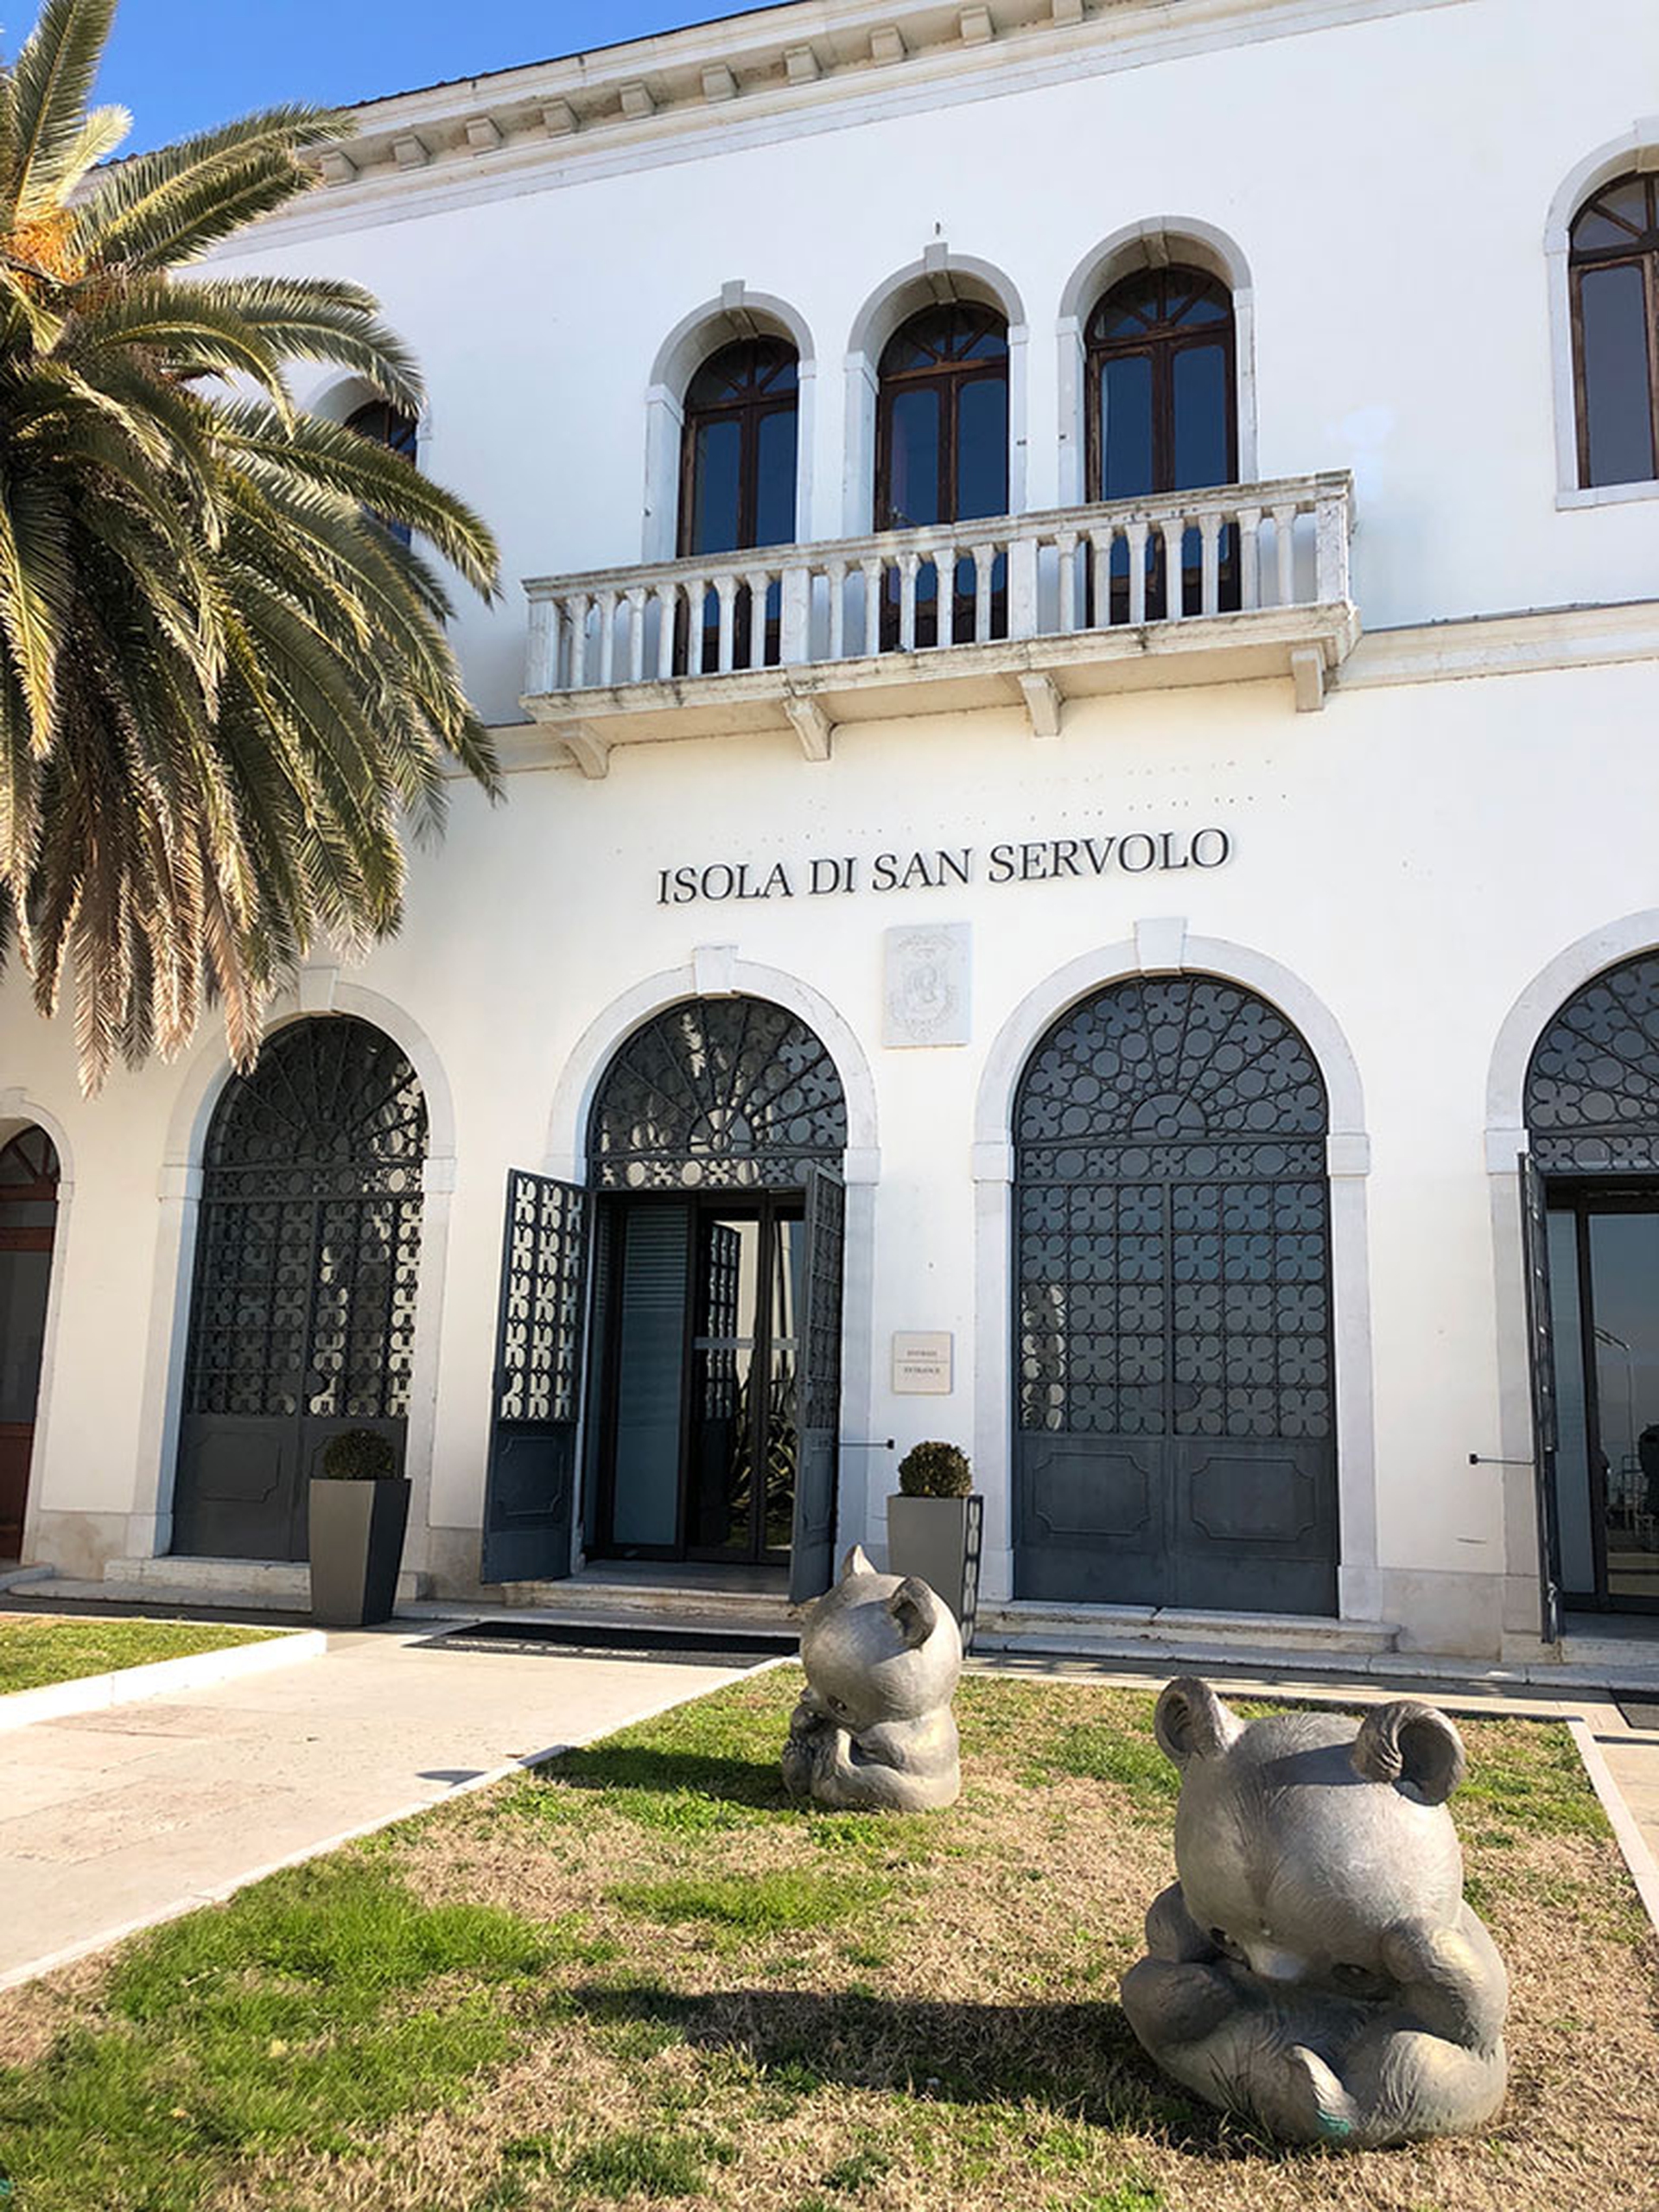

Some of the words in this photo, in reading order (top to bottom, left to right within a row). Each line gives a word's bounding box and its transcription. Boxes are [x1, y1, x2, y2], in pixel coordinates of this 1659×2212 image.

[657, 862, 794, 905] ISOLA
[809, 858, 856, 895] DI
[872, 849, 971, 891] SAN
[988, 828, 1229, 882] SERVOLO
